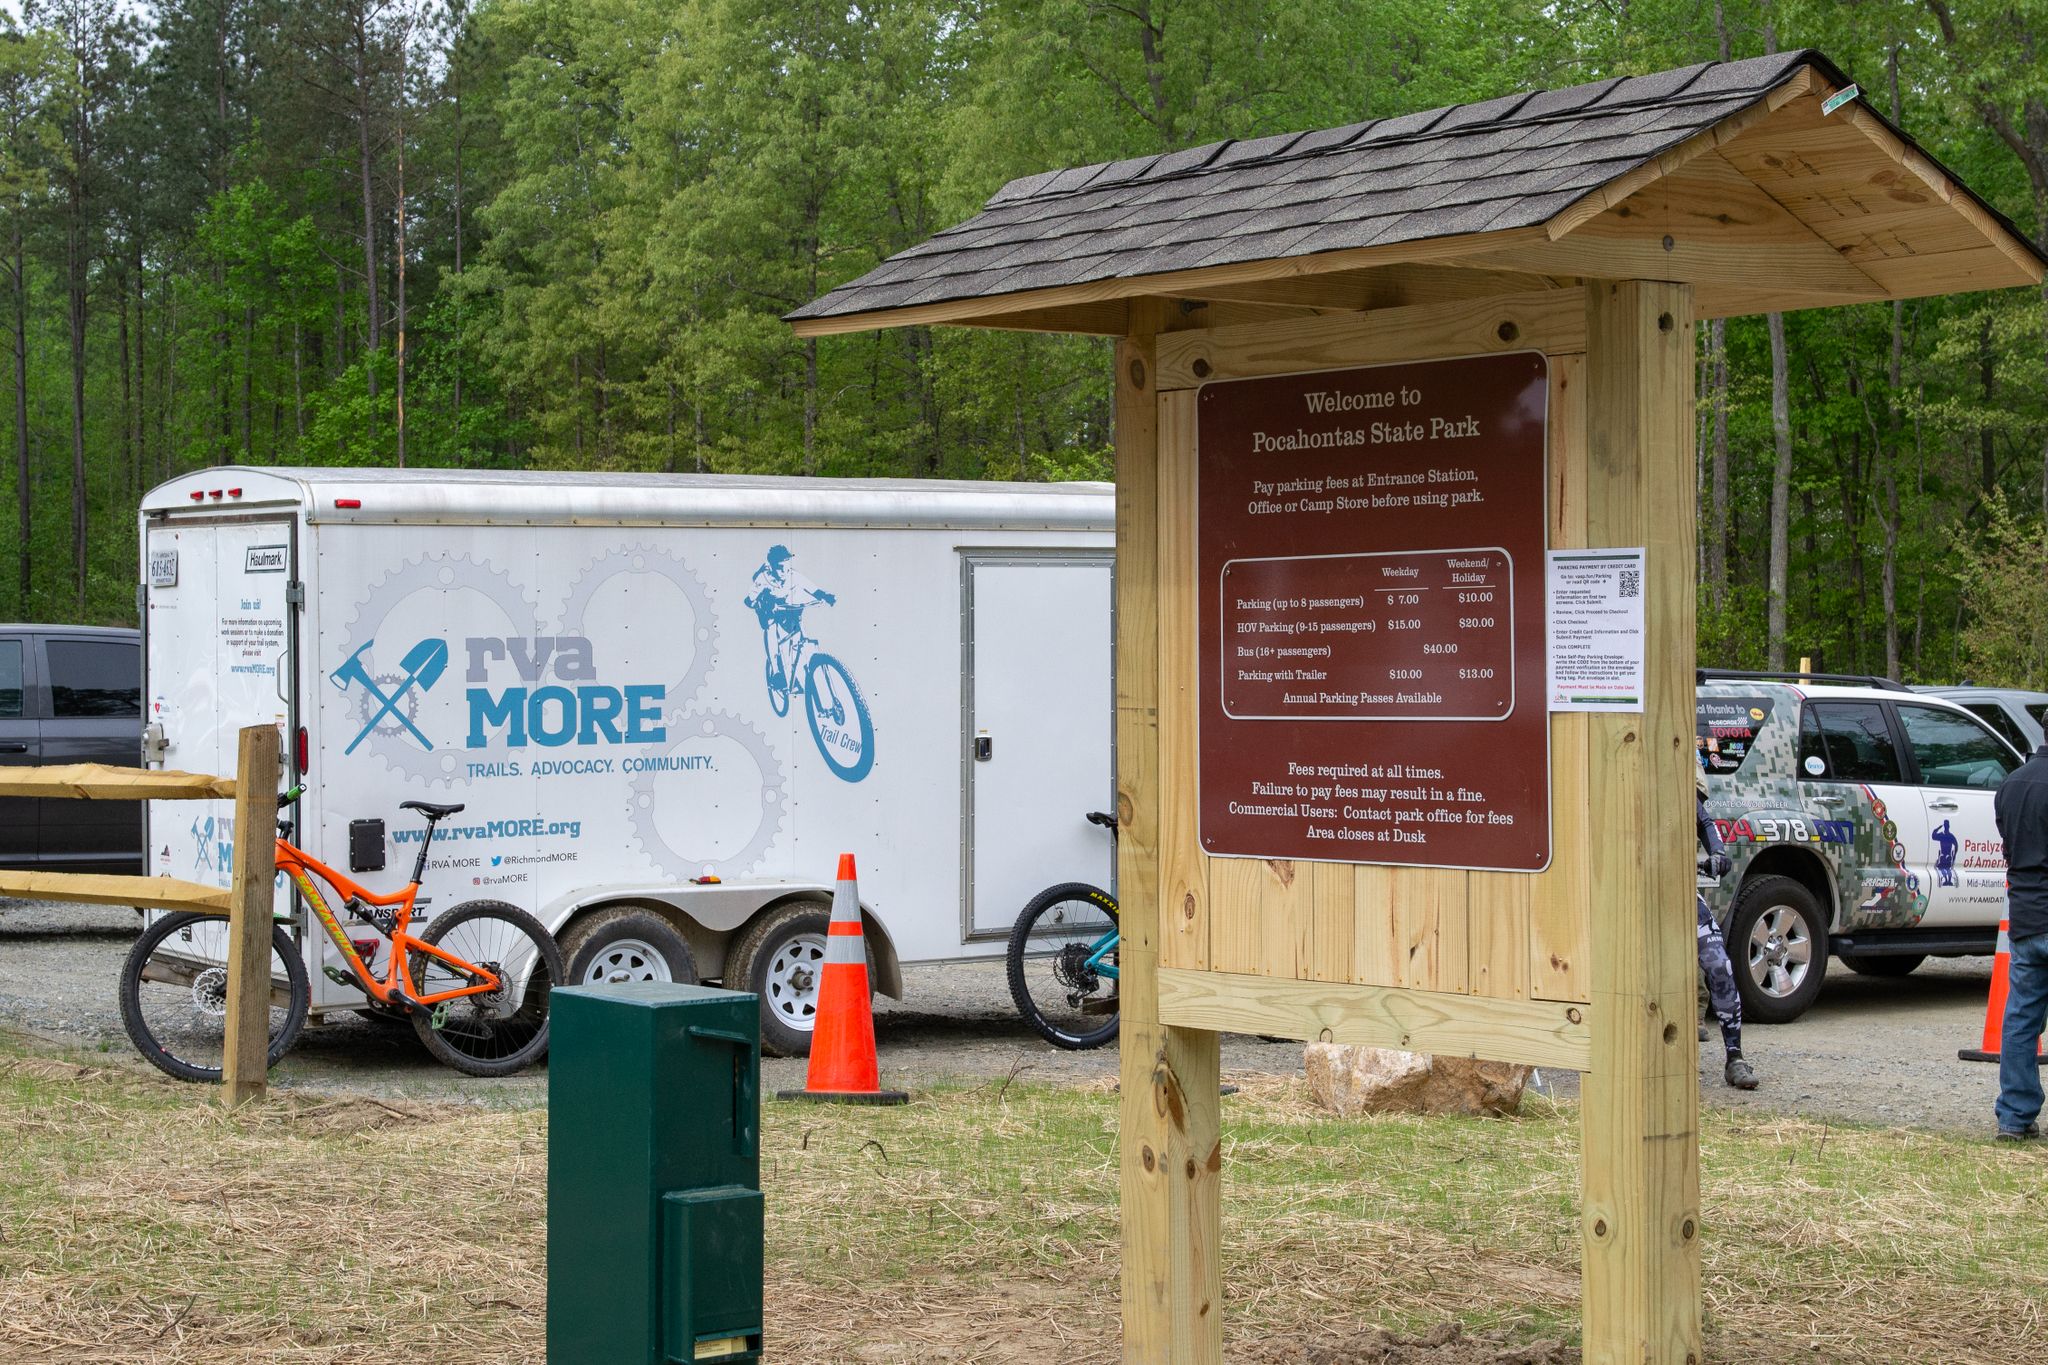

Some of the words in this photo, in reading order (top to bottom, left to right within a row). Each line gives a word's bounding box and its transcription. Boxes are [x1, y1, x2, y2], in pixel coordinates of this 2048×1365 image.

[1305, 391, 1395, 413] Welcome
[1400, 386, 1421, 406] to
[1253, 428, 1365, 452] Pocahontas
[1371, 421, 1424, 444] State
[1431, 416, 1480, 439] Park
[1254, 480, 1274, 496] Pay
[1277, 478, 1323, 496] parking
[1326, 476, 1348, 490] fees
[1352, 475, 1364, 488] at
[1368, 472, 1425, 487] Entrance
[1428, 469, 1479, 484] Station,
[1248, 500, 1281, 515] Office
[1285, 500, 1297, 513] or
[1300, 498, 1333, 513] Camp
[1337, 497, 1368, 511] Store
[1372, 494, 1410, 508] before
[1413, 492, 1448, 507] using
[1452, 490, 1484, 505] park.
[250, 552, 282, 567] Haulmark
[1447, 559, 1490, 569] Weekend/
[1382, 567, 1419, 578] Weekday
[1452, 572, 1486, 584] Holiday
[1237, 598, 1271, 610] Parking
[1273, 598, 1288, 610] (up
[1290, 599, 1299, 608] to
[1301, 598, 1307, 607] 8
[1309, 596, 1364, 609] passengers)
[1388, 595, 1394, 604] $
[1399, 595, 1419, 604] 7.00
[1459, 592, 1493, 603] $10.00
[241, 599, 251, 610] Join
[1237, 622, 1256, 633] HOV
[1259, 622, 1294, 634] Parking
[1296, 620, 1319, 633] (9-15
[1320, 618, 1376, 633] passengers)
[1388, 619, 1421, 630] $15.00
[1459, 617, 1494, 628] $20.00
[1237, 647, 1253, 657] Bus
[1255, 646, 1275, 659] (16+
[1277, 645, 1331, 658] passengers)
[1424, 643, 1458, 654] $40.00
[466, 637, 596, 682] rva
[1238, 670, 1272, 682] Parking
[1274, 670, 1293, 681] with
[1295, 669, 1327, 680] Trailer
[1390, 669, 1422, 680] $10.00
[1459, 668, 1494, 679] $13.00
[1283, 693, 1317, 704] Annual
[1320, 693, 1358, 706] Parking
[1361, 693, 1393, 704] Passes
[1396, 693, 1442, 704] Available
[466, 685, 666, 748] MORE
[821, 724, 840, 744] Trail
[841, 734, 862, 754] Crew
[1712, 728, 1752, 738] TOYOTA
[467, 763, 523, 777] TRAILS.
[531, 759, 614, 775] ADVOCACY.
[622, 756, 713, 773] COMMUNITY.
[1288, 763, 1315, 776] Fees
[1318, 764, 1368, 779] required
[1372, 765, 1384, 778] at
[1387, 765, 1402, 778] all
[1406, 765, 1444, 779] times.
[1252, 782, 1293, 796] Failure
[1296, 785, 1308, 797] to
[1311, 787, 1332, 802] pay
[1335, 785, 1358, 798] fees
[1361, 789, 1387, 804] may
[1390, 787, 1426, 800] result
[1431, 787, 1443, 801] in
[1447, 792, 1454, 801] a
[1457, 788, 1485, 802] fine.
[1705, 800, 1735, 808] DONATE
[1747, 800, 1788, 809] VOLUNTEER
[1229, 802, 1298, 818] Commercial
[1301, 804, 1338, 819] Users:
[1344, 806, 1392, 820] Contact
[1395, 807, 1424, 824] park
[1427, 808, 1462, 822] office
[1466, 809, 1485, 824] for
[1488, 810, 1513, 825] fees
[393, 819, 581, 843] www.rvaMORE.org
[1307, 826, 1335, 839] Area
[1337, 827, 1374, 841] closes
[1378, 829, 1390, 842] at
[1393, 830, 1426, 843] Dusk
[1964, 839, 2003, 855] Paralyze
[432, 859, 450, 869] RVA
[452, 857, 481, 868] MORE
[504, 852, 578, 865] @RichmondMORE
[1963, 856, 1974, 868] of
[483, 873, 528, 885] @rvaMORE
[1966, 878, 2005, 888] Mid-Atlantic
[297, 875, 332, 922] SANTA
[1089, 892, 1120, 914] MAXXIS
